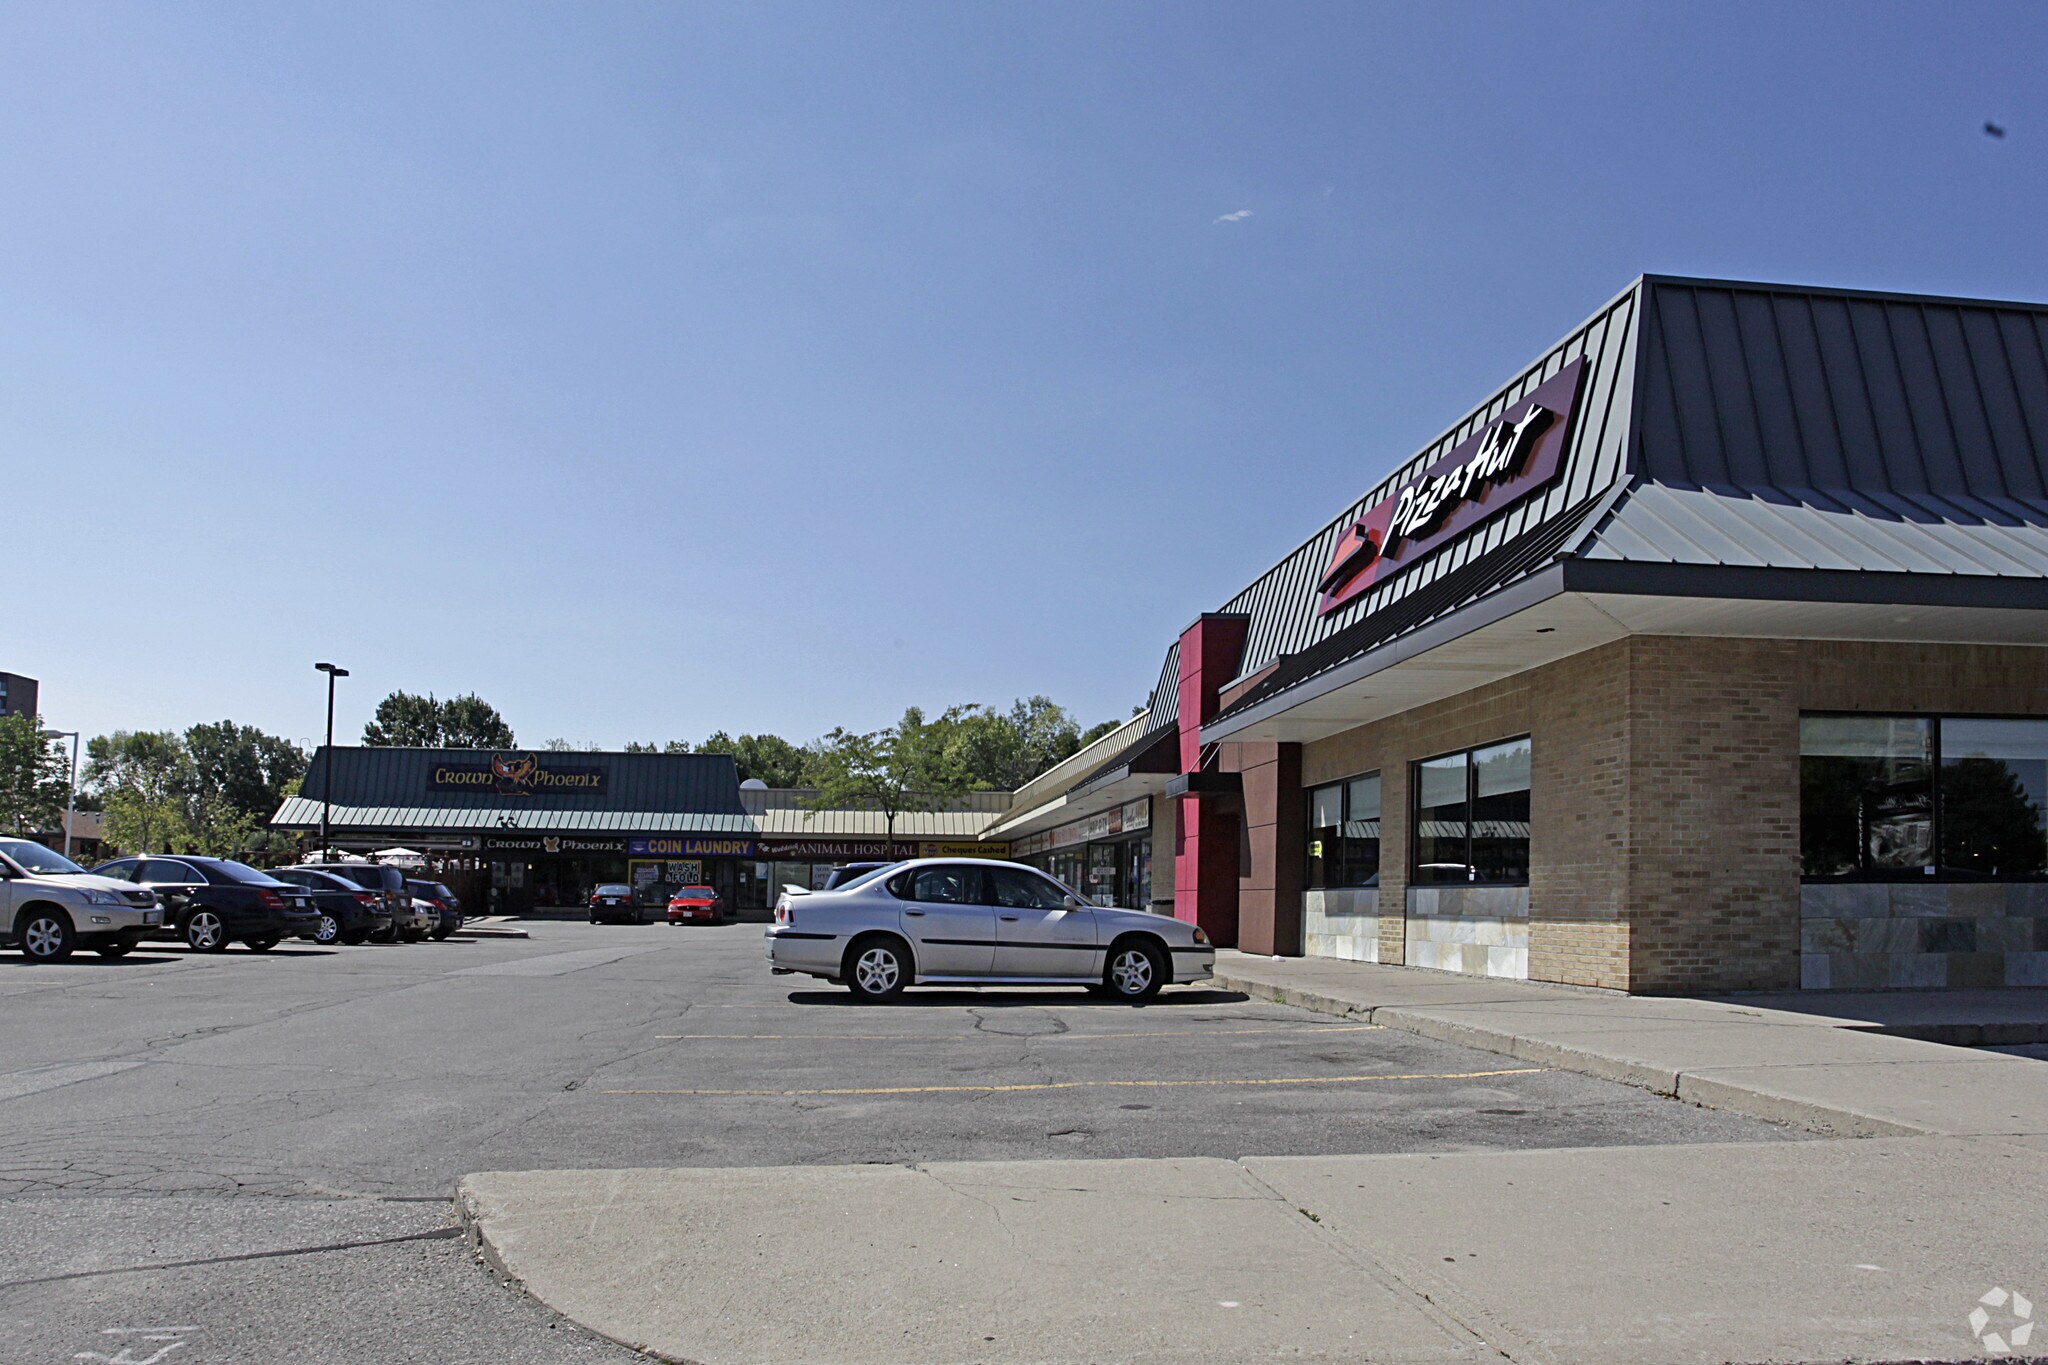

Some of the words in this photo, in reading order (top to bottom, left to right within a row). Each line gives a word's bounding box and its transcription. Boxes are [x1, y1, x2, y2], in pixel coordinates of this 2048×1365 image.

[1379, 464, 1464, 556] Pizza
[1460, 403, 1542, 498] Hut
[534, 770, 601, 787] Phoenix
[562, 840, 624, 851] Phoenix
[648, 840, 682, 853] COIN
[686, 840, 750, 854] LAUNDRY
[798, 843, 851, 855] ANIMAL
[854, 844, 917, 856] HOSPTAL
[942, 846, 976, 855] Cheques
[978, 846, 1006, 854] Cashed
[668, 862, 698, 873] WASH
[672, 873, 699, 883] FOLD
